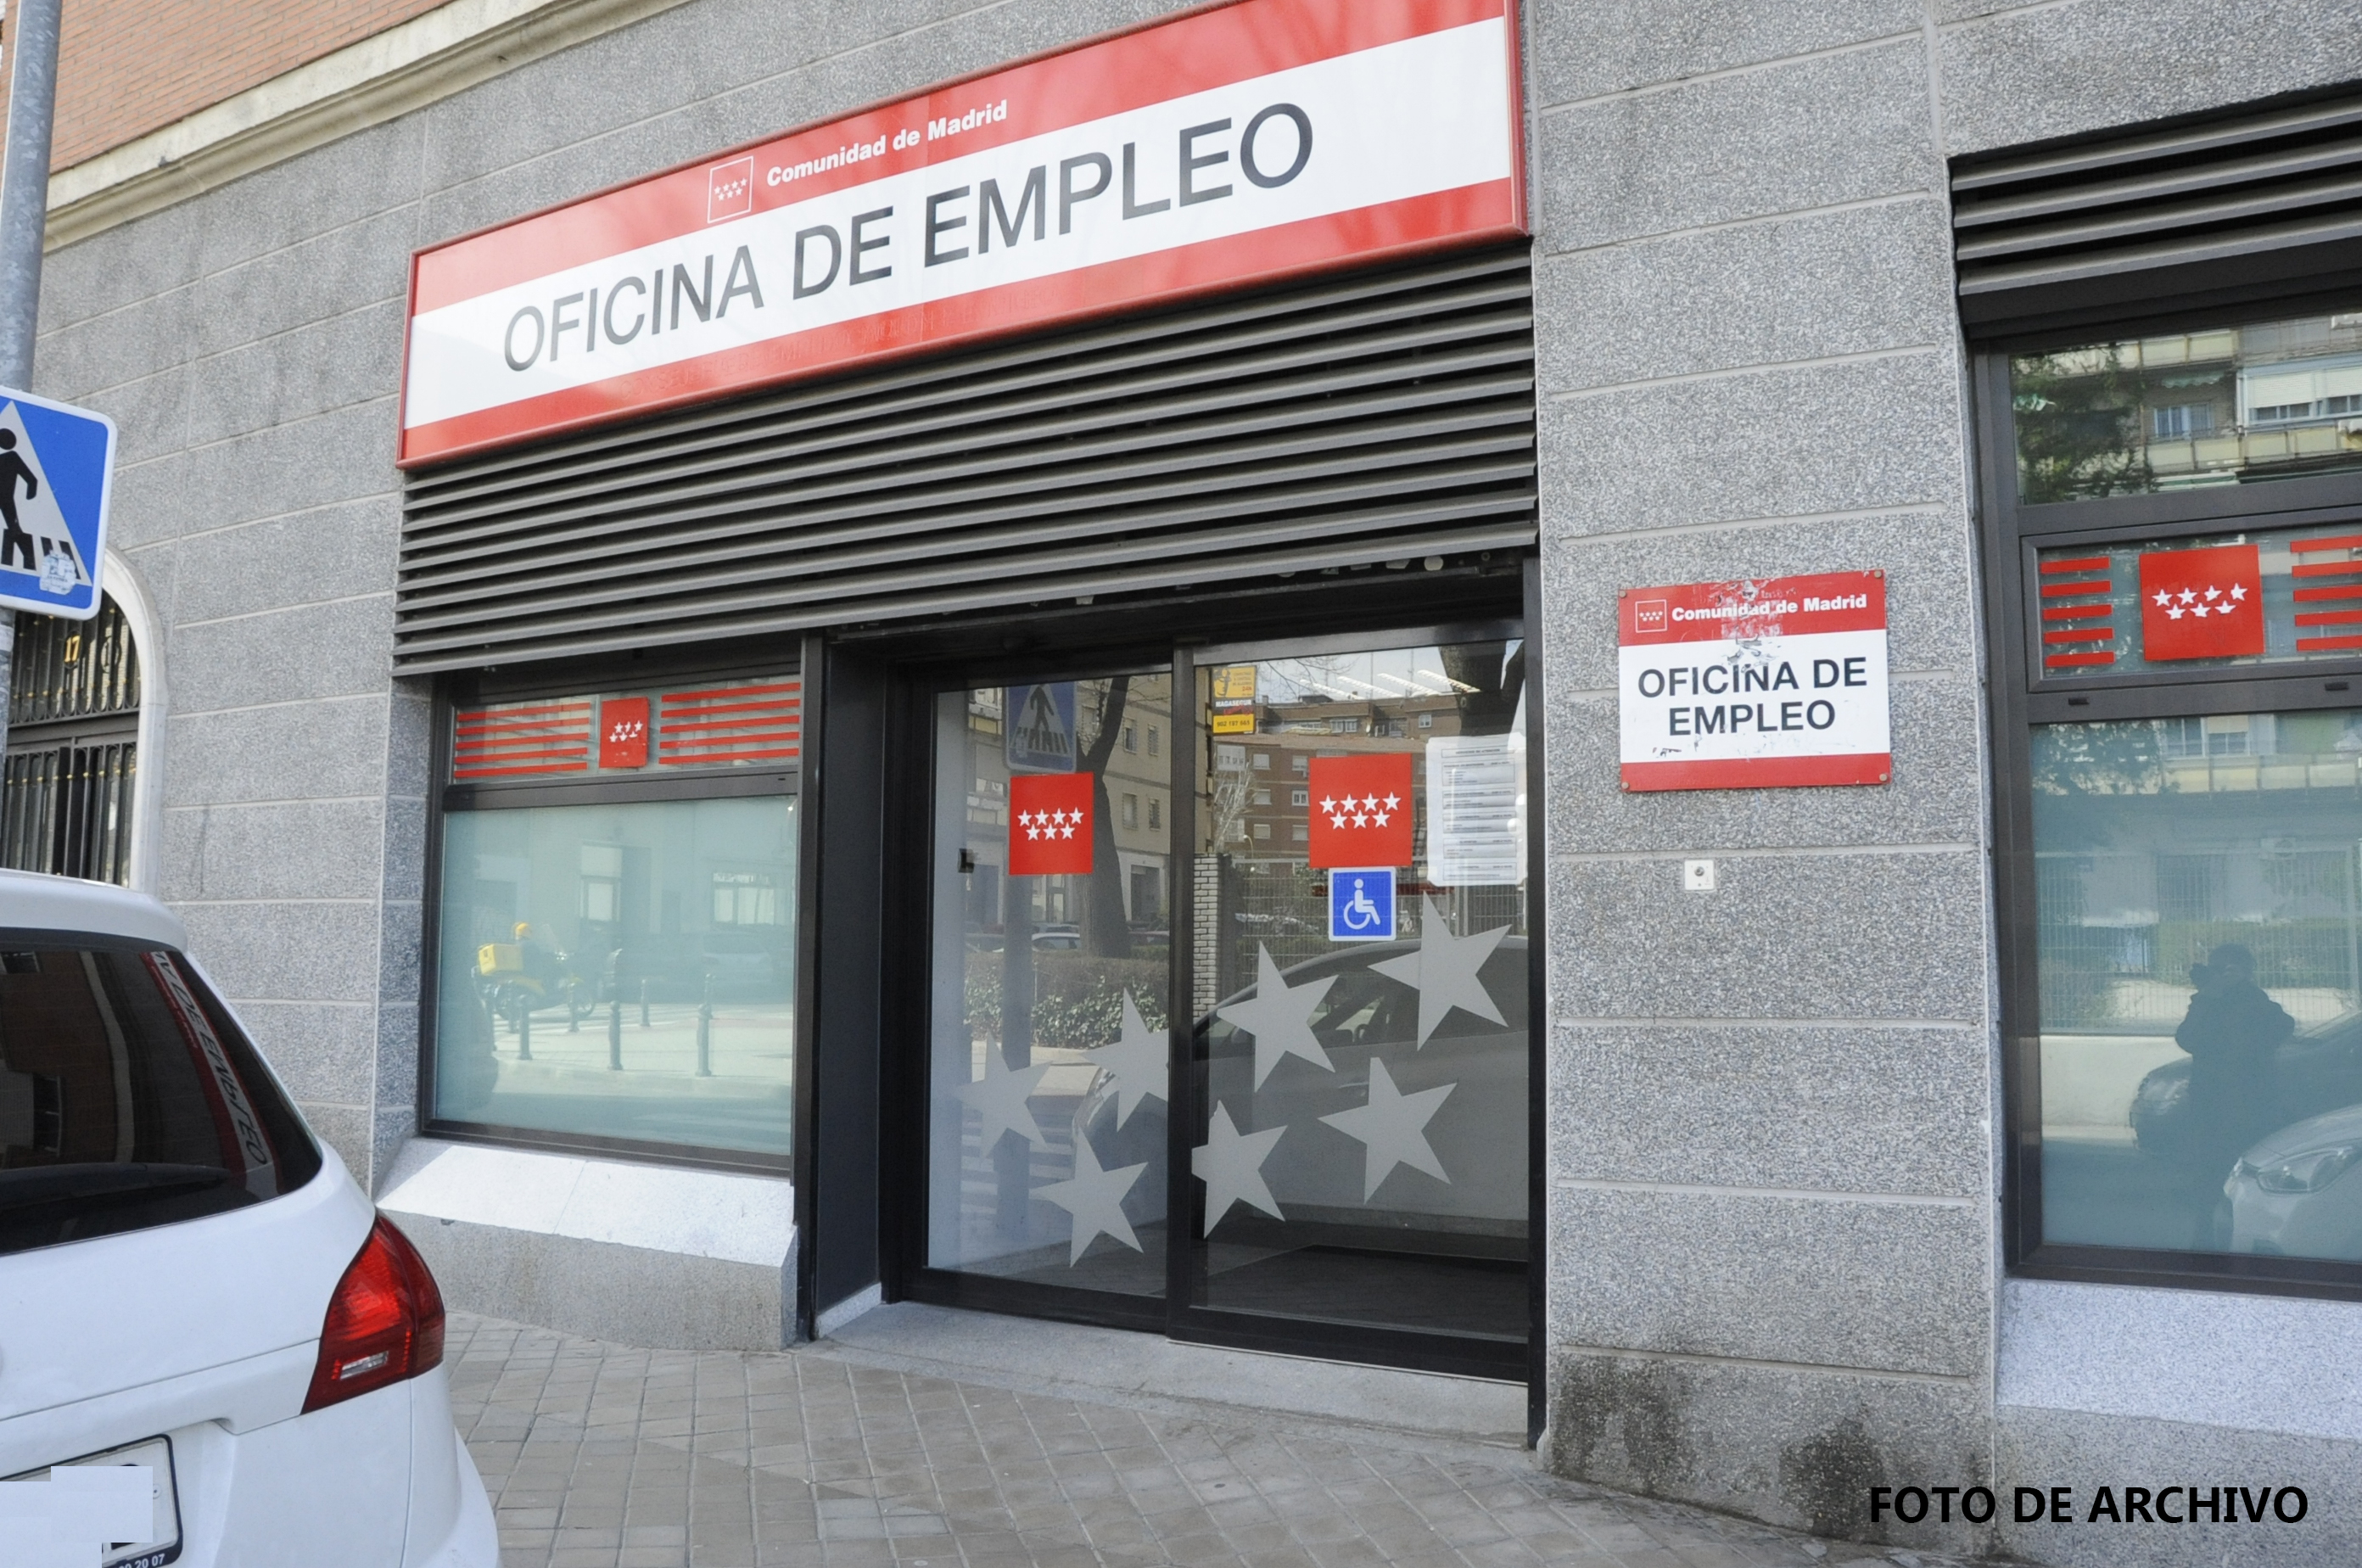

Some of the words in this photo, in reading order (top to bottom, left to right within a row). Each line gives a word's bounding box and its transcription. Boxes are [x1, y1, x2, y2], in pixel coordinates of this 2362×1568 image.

[767, 135, 886, 187] Comunidad
[893, 129, 921, 151] de
[927, 99, 1008, 142] Madrid
[504, 244, 764, 372] OFICINA
[792, 205, 894, 300] DE
[923, 103, 1313, 269] EMPLEO
[1671, 601, 1771, 622] Comunidad
[1777, 598, 1798, 613] de
[1803, 594, 1867, 613] Madrid
[64, 635, 81, 663] 17
[1637, 661, 1799, 698] OFICINA
[1813, 657, 1867, 689] DE
[1669, 699, 1836, 736] EMPLEO
[151, 1553, 165, 1566] 07
